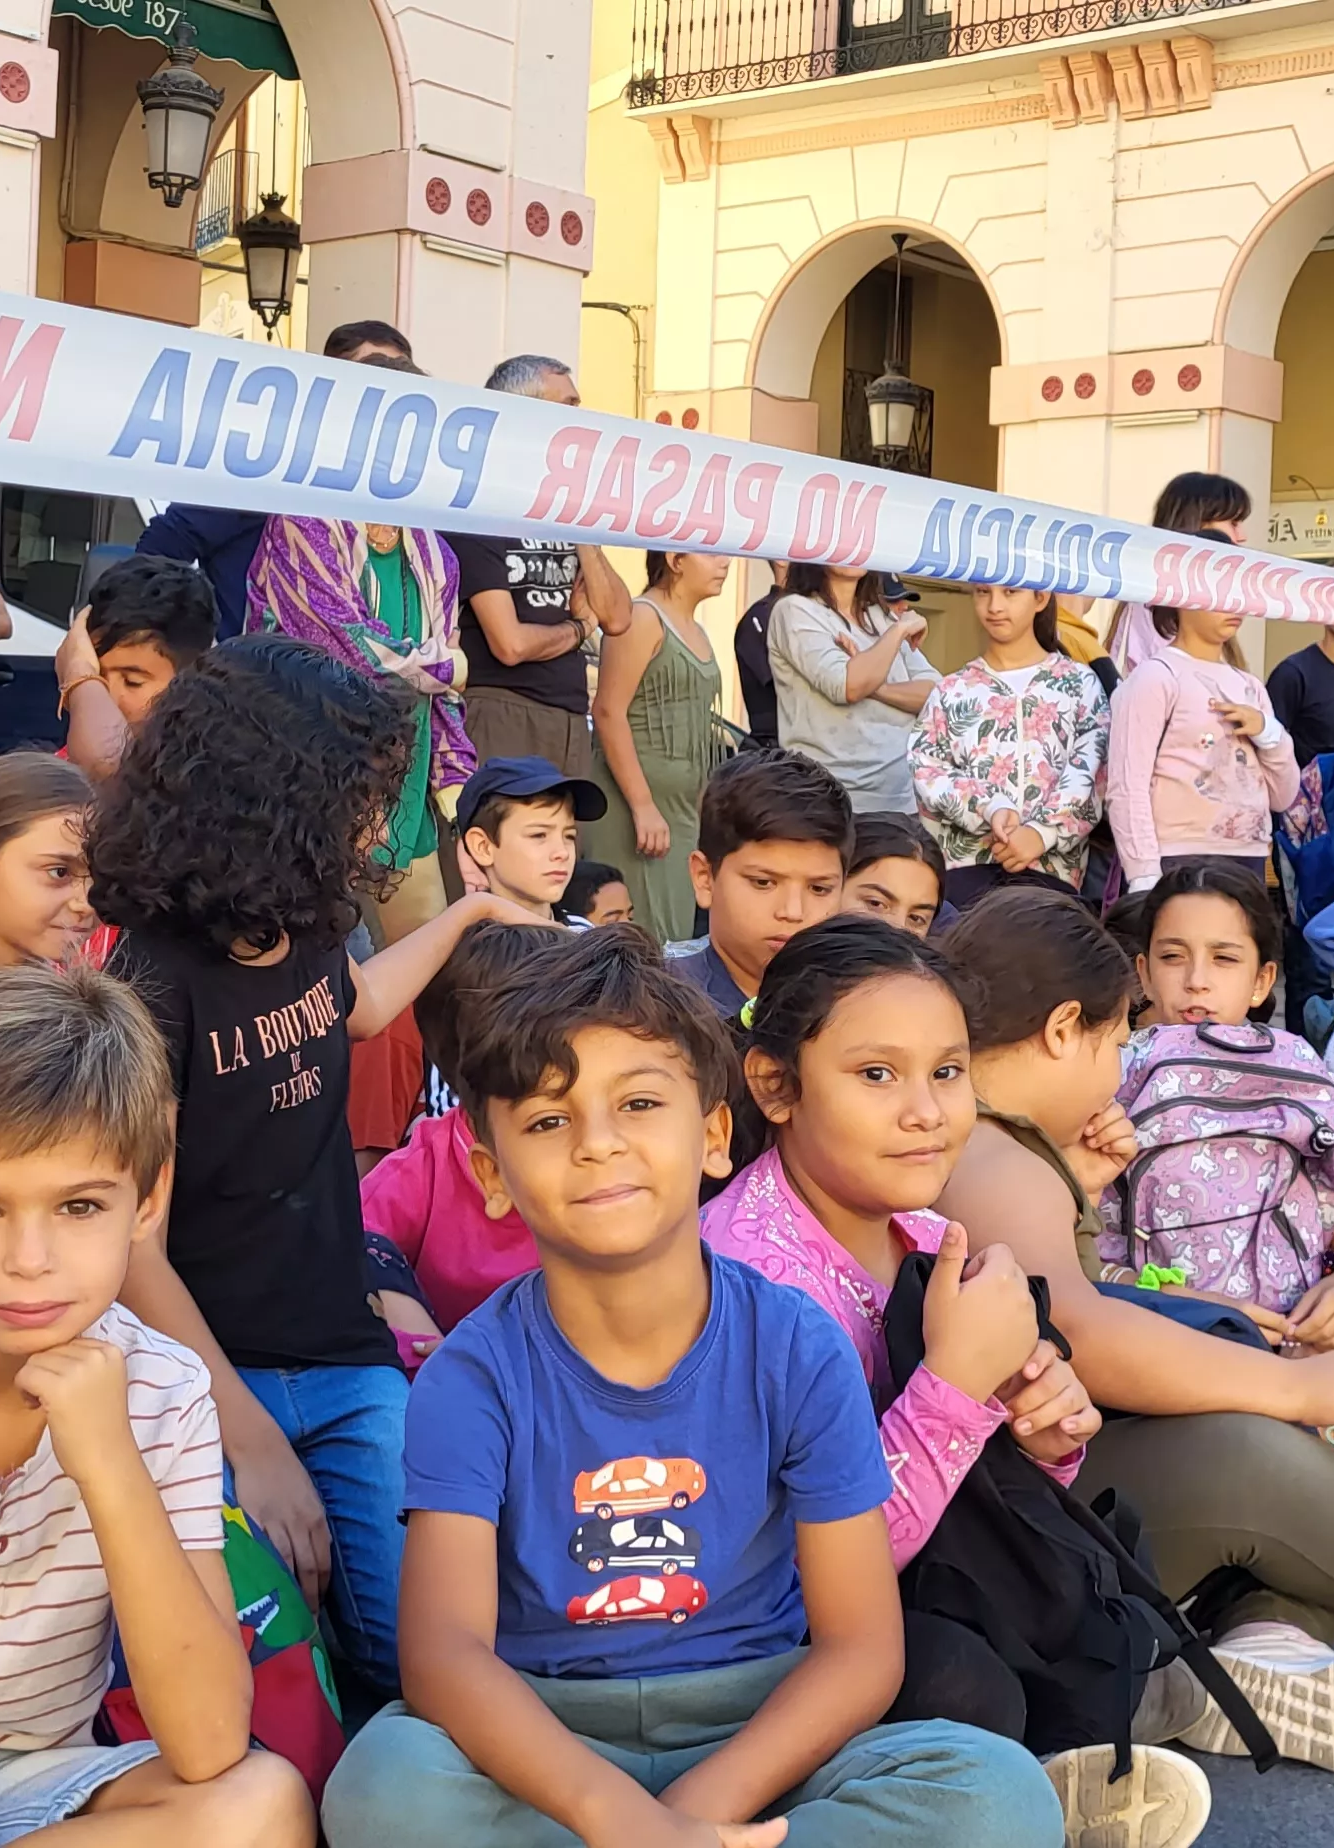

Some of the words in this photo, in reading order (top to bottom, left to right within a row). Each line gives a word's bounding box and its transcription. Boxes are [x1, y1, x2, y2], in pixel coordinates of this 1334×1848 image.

[144, 1, 181, 35] 187
[208, 1025, 251, 1075] LA
[253, 975, 340, 1059] BOUTIQUE
[269, 1065, 322, 1113] FLEURS
